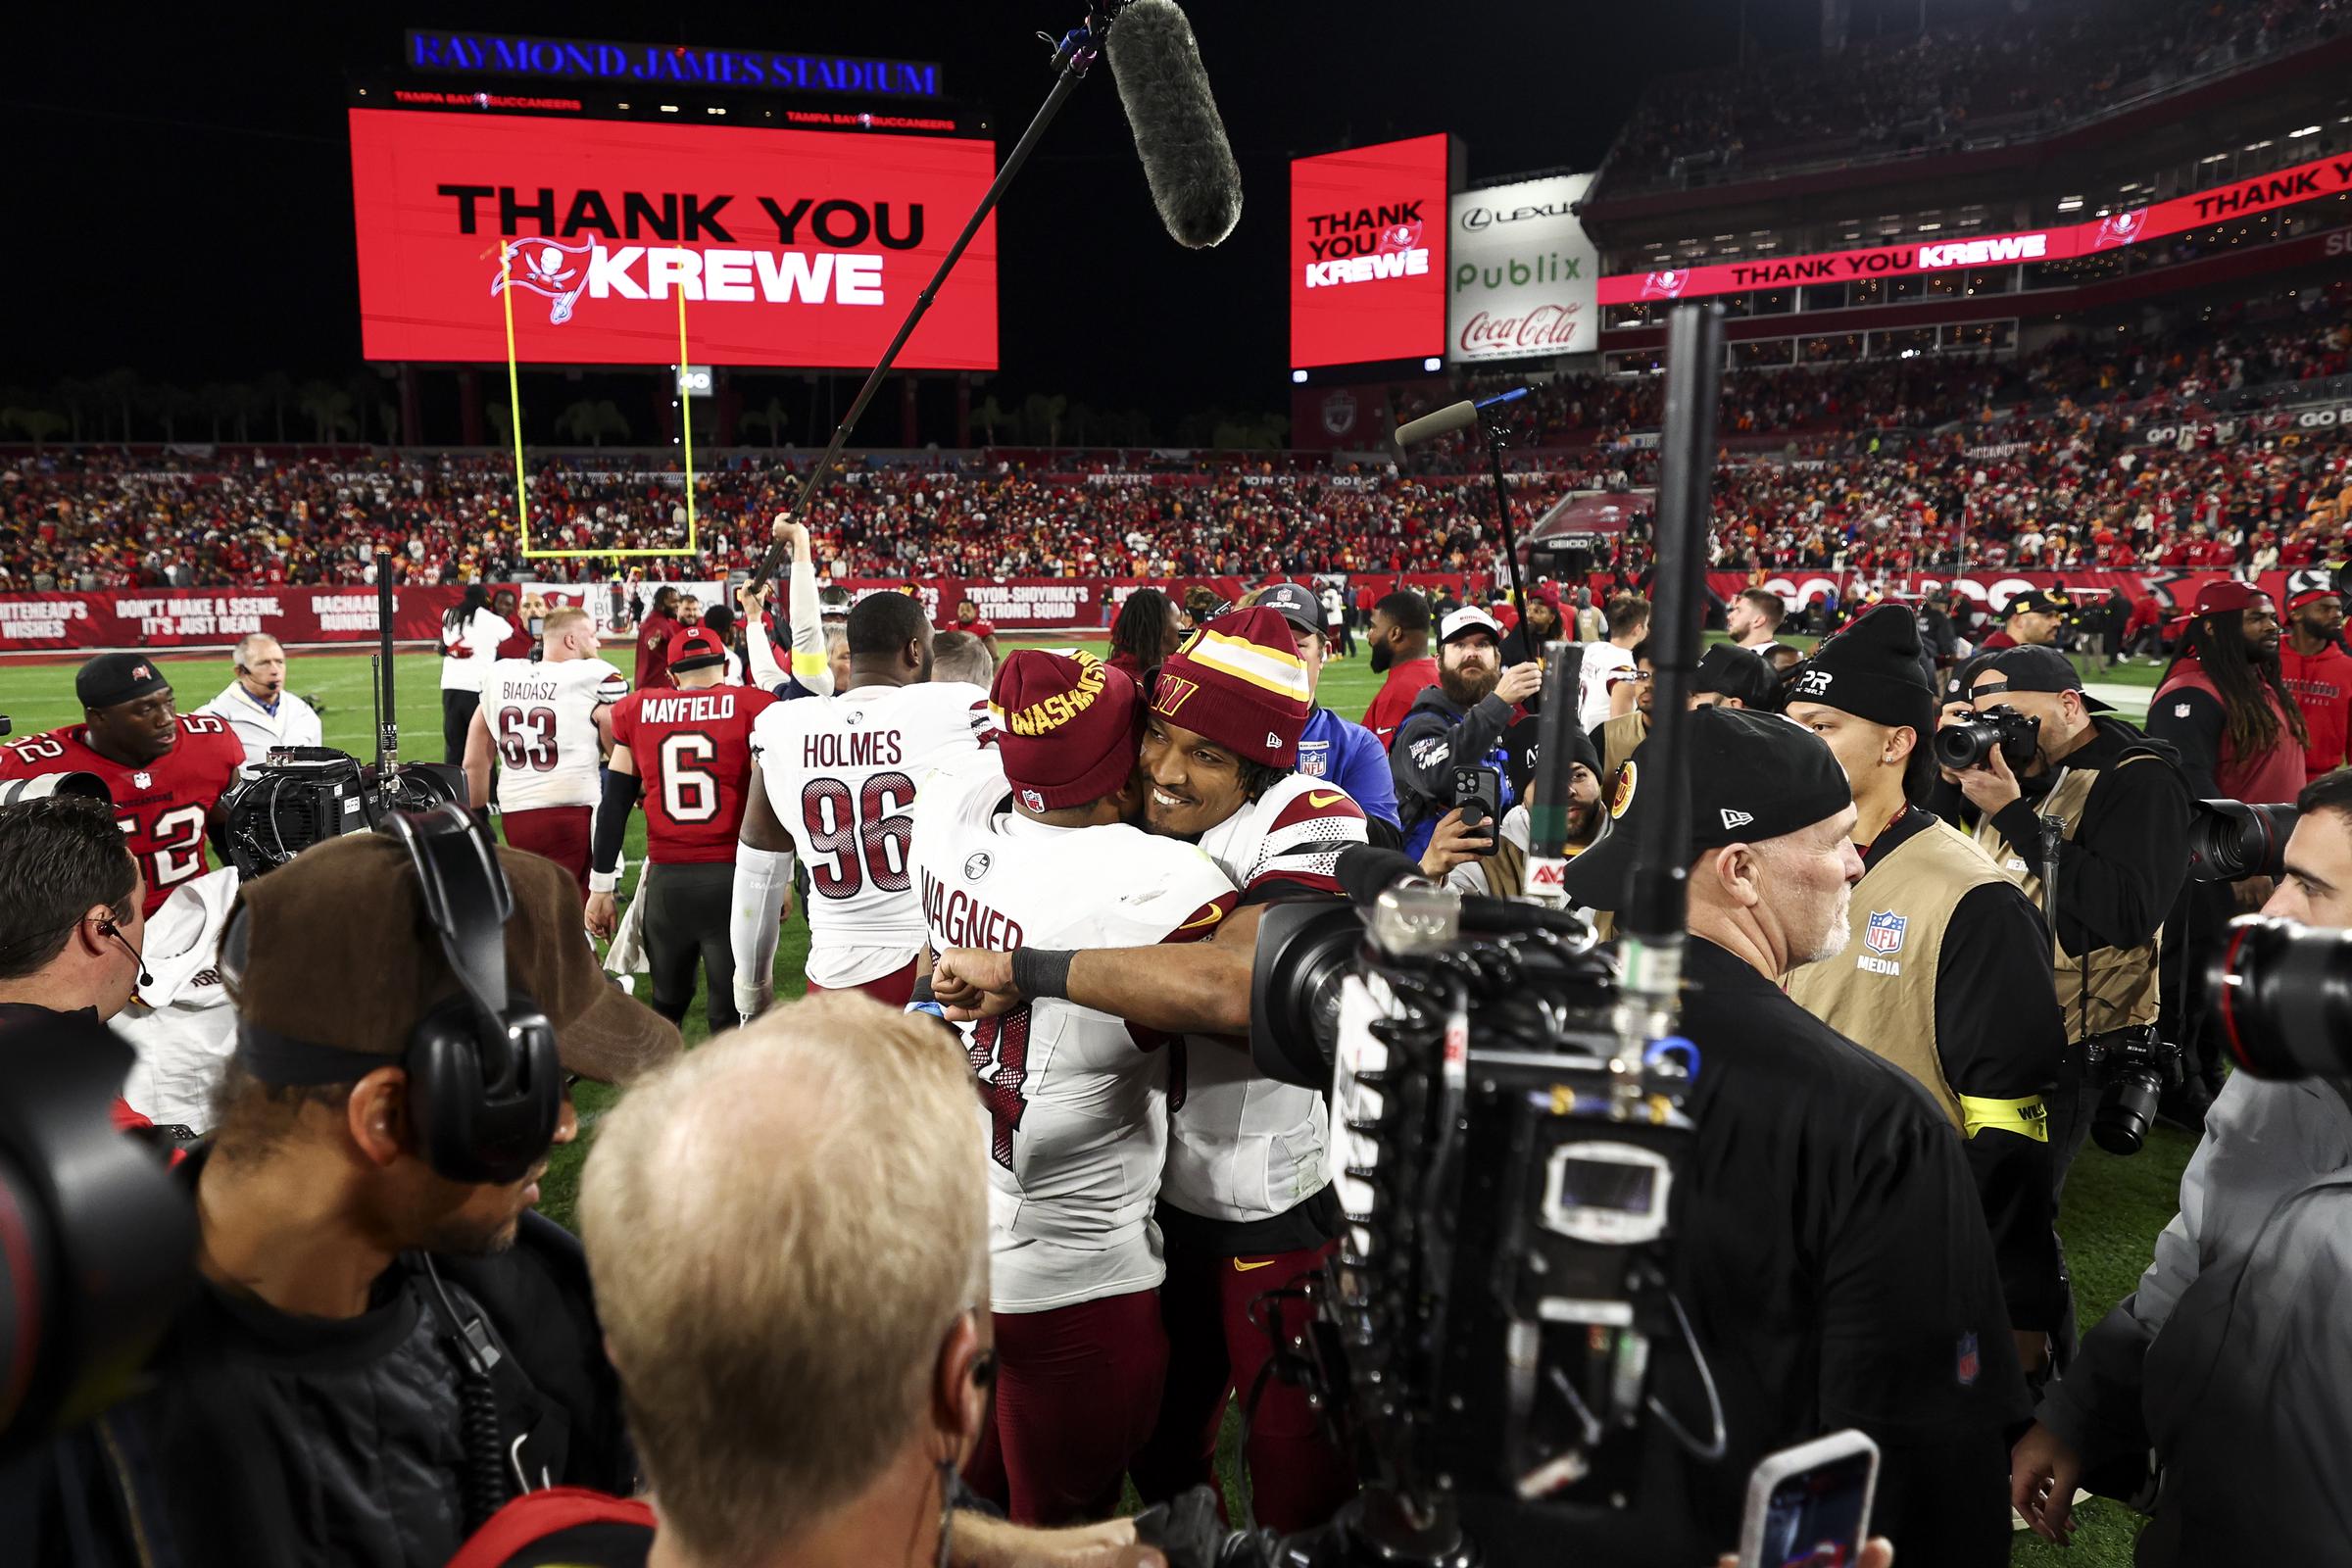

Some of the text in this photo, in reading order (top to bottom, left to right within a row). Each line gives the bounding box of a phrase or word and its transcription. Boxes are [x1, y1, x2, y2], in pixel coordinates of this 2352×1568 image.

[413, 33, 937, 95] RAYMOND JAMES STADIUM
[394, 89, 582, 112] TAMPA BAY BUCCANEERS
[785, 110, 956, 131] TAMPA BAY BUCCANEERS
[2193, 167, 2321, 220] THANK
[437, 184, 924, 250] THANK YOU
[1307, 199, 1425, 237] THANK
[1308, 231, 1377, 261] YOU
[1731, 233, 2047, 286] THANK YOU KREWE
[587, 244, 885, 306] KREWE
[1305, 248, 1429, 288] KREWE
[1460, 302, 1586, 351] Coca-Cola
[2299, 411, 2336, 427] GO
[2146, 427, 2177, 443] GO
[1548, 539, 1588, 550] GEICO
[116, 597, 284, 618] DON'T MAKE A SCENE,
[964, 586, 1090, 605] TRYON-SHOYINKA'S
[142, 614, 262, 635] IT'S JUST DEAN
[978, 602, 1077, 620] STRONG SQUAD
[503, 680, 558, 702] BIADASZ
[641, 694, 735, 723] MAYFIELD
[498, 705, 559, 773] 63
[803, 729, 903, 768] HOLMES
[660, 730, 719, 825] 6
[802, 771, 917, 900] 96
[920, 864, 1026, 955] WAGNER
[1869, 927, 1897, 949] NFL
[1857, 955, 1900, 976] MEDIA
